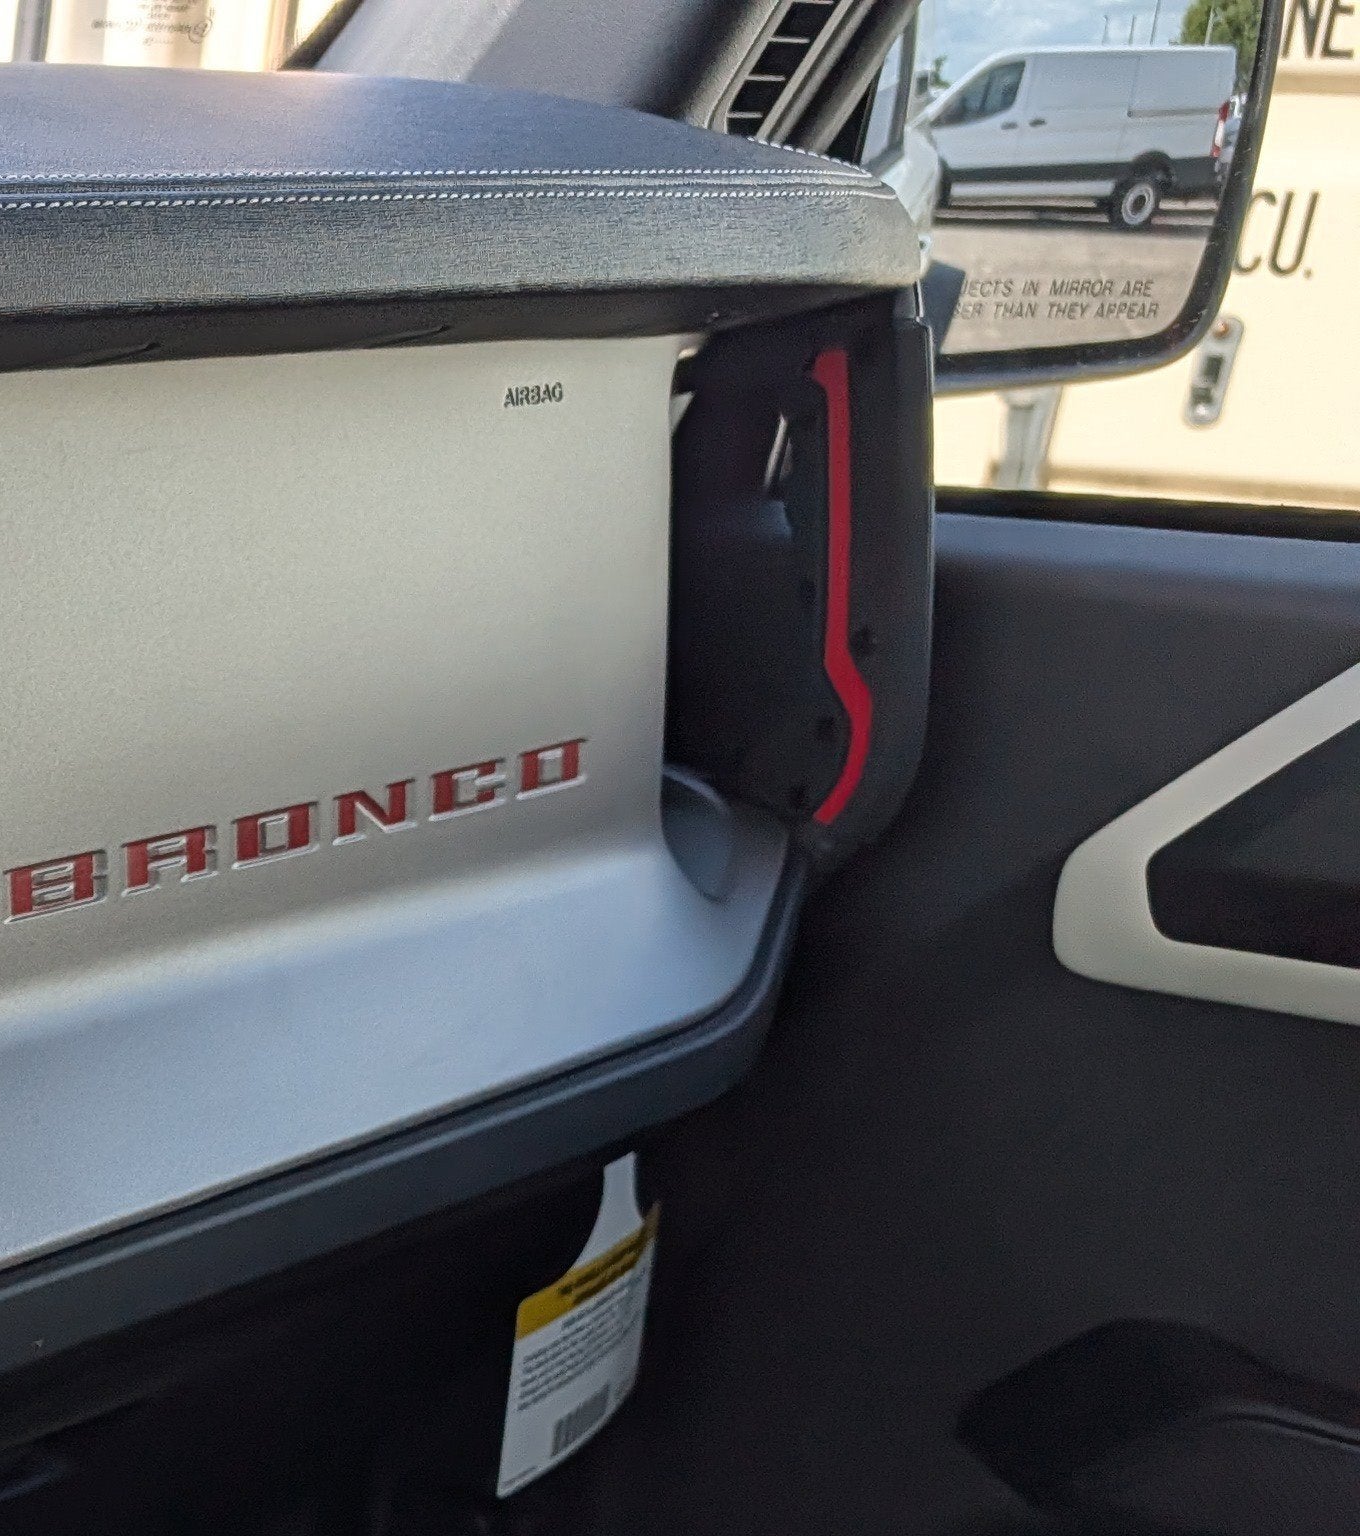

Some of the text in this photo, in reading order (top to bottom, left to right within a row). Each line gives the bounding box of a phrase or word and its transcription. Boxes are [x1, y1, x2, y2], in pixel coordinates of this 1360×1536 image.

[1022, 279, 1040, 298] IN
[1049, 279, 1114, 298] MIRROR
[1120, 279, 1155, 298] ARE
[993, 302, 1037, 320] THAN
[1046, 302, 1091, 320] THEY
[1094, 302, 1161, 321] APPEAR
[504, 382, 564, 409] AIRBAG
[3, 737, 588, 925] BRONCO
